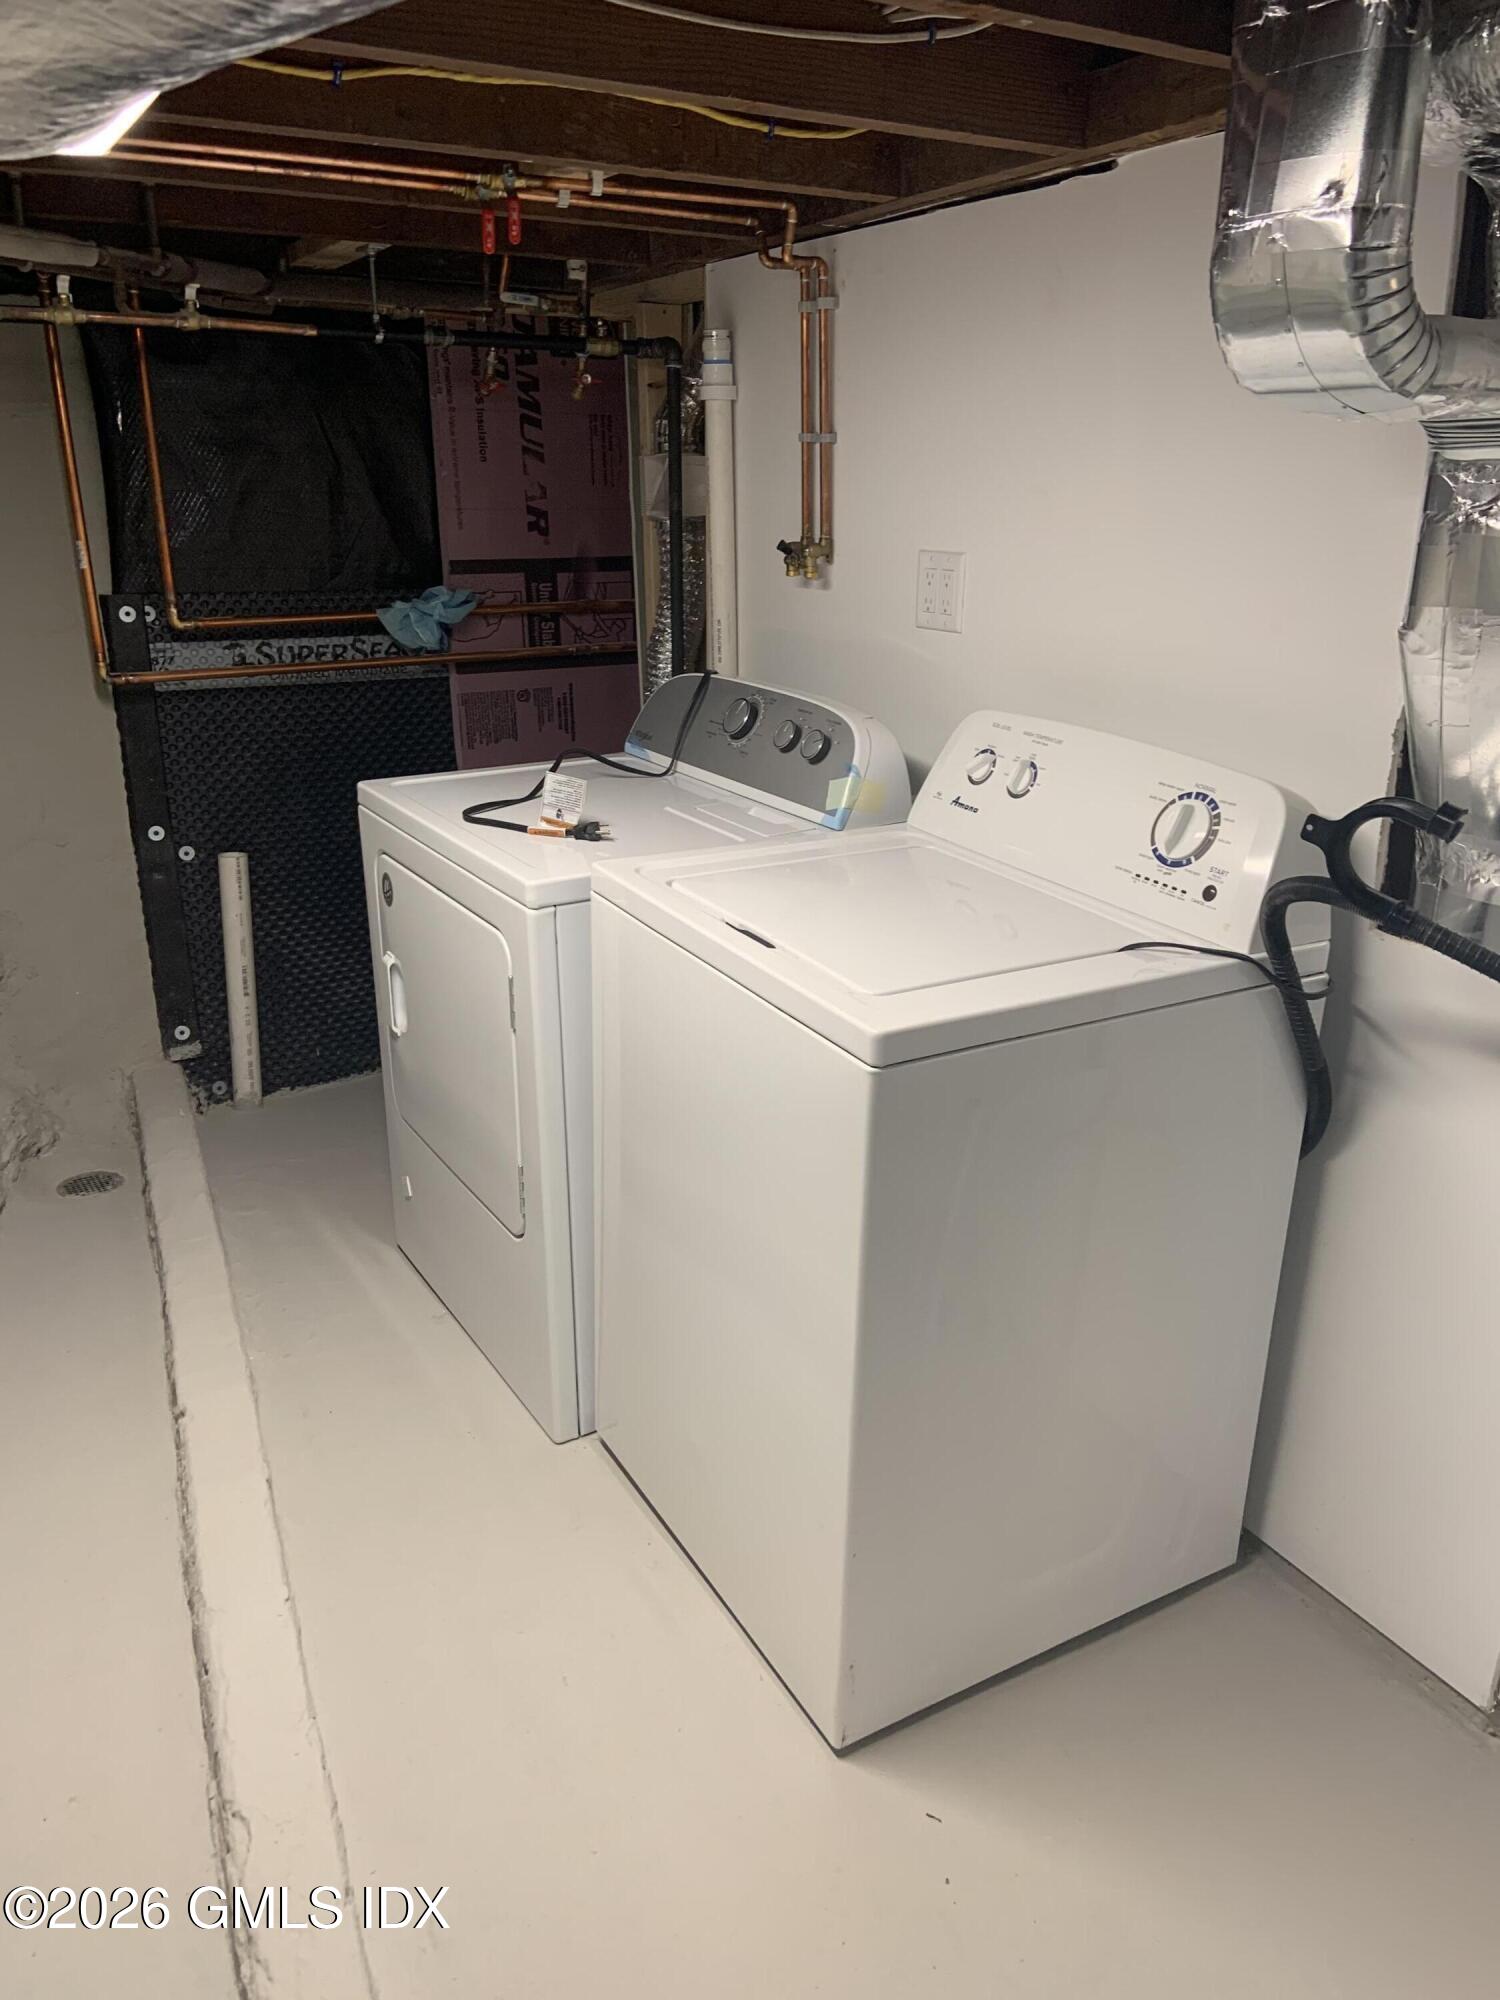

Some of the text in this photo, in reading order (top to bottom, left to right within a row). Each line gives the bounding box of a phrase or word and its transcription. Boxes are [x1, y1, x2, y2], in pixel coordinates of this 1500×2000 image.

[476, 408, 488, 463] Insulation
[540, 621, 557, 648] Slab
[950, 795, 979, 814] Amana
[1208, 865, 1230, 877] START
